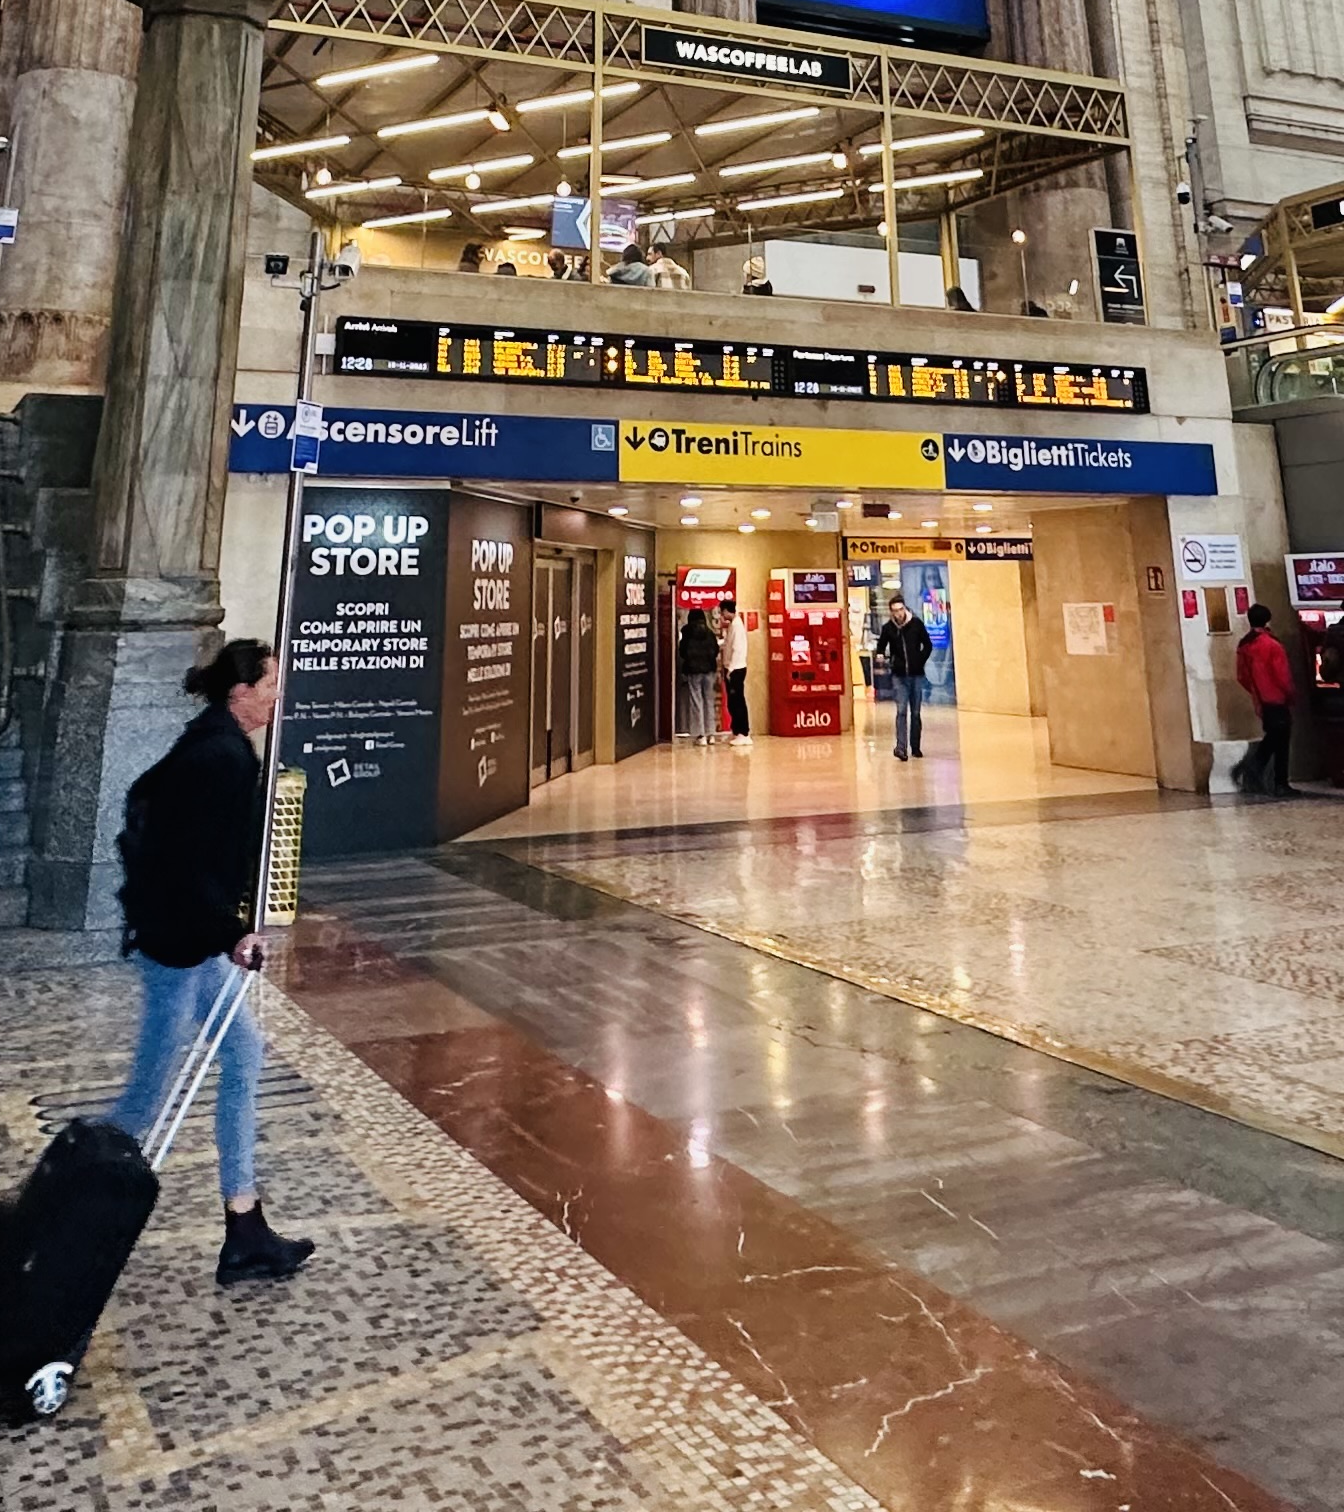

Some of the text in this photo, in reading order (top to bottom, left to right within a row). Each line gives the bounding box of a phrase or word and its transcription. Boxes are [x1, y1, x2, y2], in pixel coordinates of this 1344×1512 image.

[676, 40, 823, 78] WASCOFFEELAB
[303, 514, 429, 544] POP UP
[309, 547, 420, 576] STORE
[471, 539, 514, 573] POP UP
[336, 602, 389, 615] SCOPRI
[473, 578, 510, 610] STORE
[300, 619, 421, 634] COME APRIRE UN
[291, 637, 428, 652] TEMPORARY STORE
[292, 655, 424, 671] NELLE STAZIONI DI
